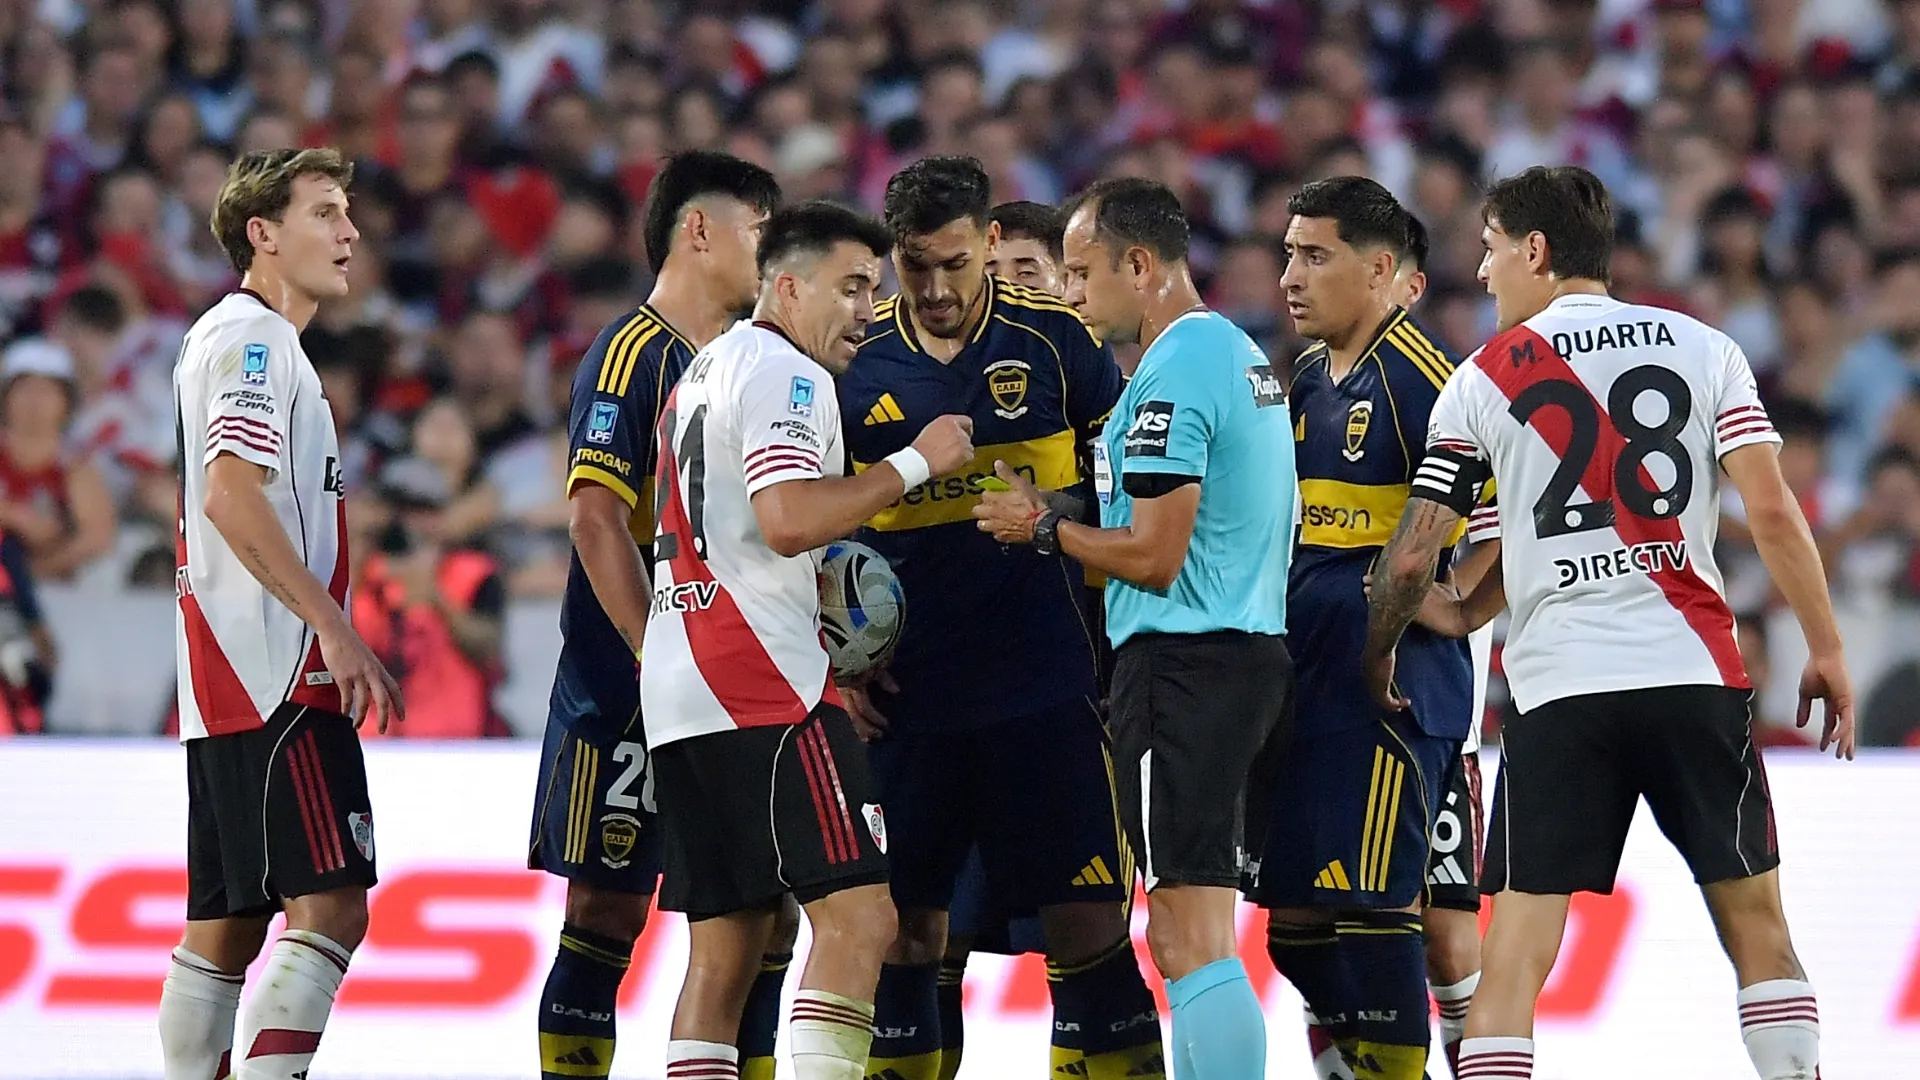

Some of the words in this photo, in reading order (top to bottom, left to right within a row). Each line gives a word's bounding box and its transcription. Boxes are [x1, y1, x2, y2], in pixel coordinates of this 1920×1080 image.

[1510, 338, 1545, 368] M.
[1552, 321, 1677, 361] QUARTA
[243, 371, 266, 384] LPF
[996, 382, 1021, 392] CABJ
[220, 389, 275, 402] ASSIST
[235, 400, 275, 415] CARD
[790, 401, 812, 416] LPF
[588, 429, 612, 442] LPF
[1507, 363, 1694, 541] 28
[571, 448, 632, 476] TROGAR
[887, 459, 1036, 509] etssn
[1301, 504, 1371, 530] sson
[1552, 542, 1686, 589] DIRECTV
[606, 834, 631, 846] CABJ
